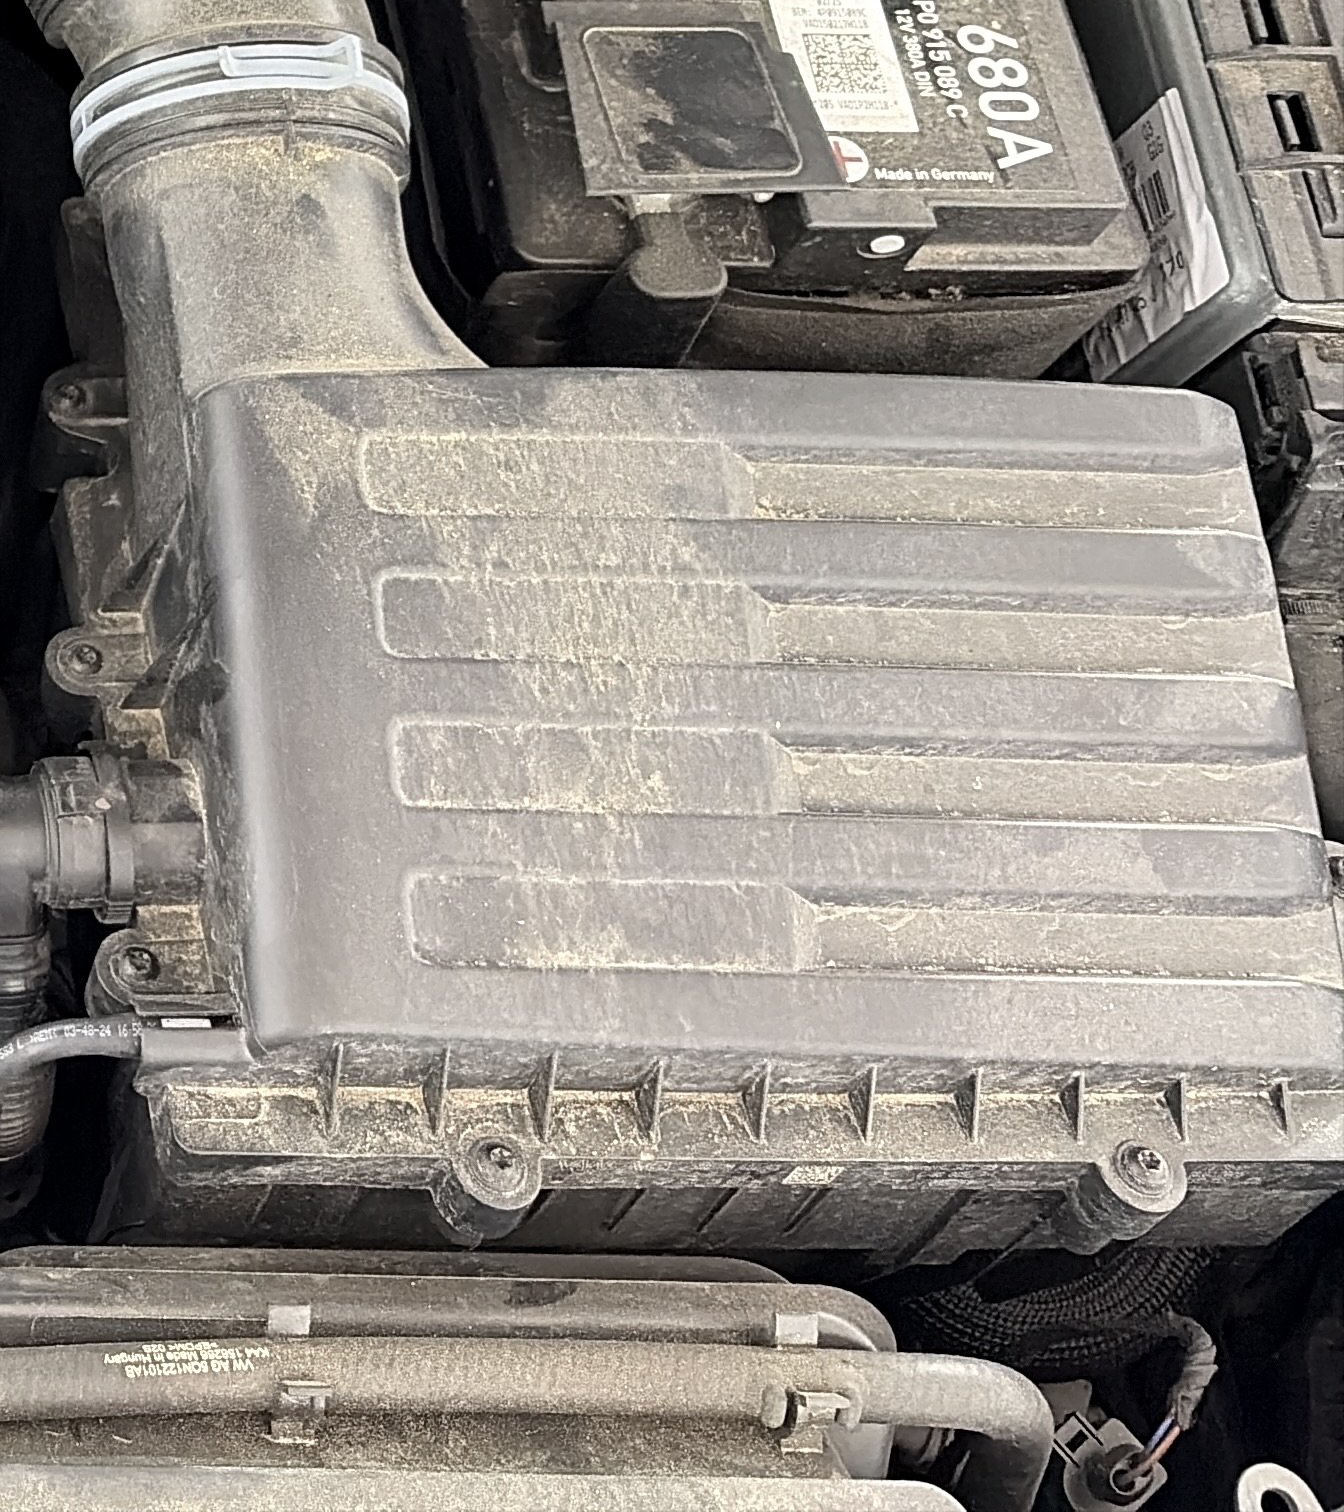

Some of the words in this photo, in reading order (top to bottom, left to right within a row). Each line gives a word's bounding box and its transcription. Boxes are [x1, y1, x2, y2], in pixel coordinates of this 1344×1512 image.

[894, 8, 916, 35] 12V
[903, 34, 926, 69] 380A
[922, 28, 952, 63] 915
[913, 70, 936, 98] DIN
[933, 65, 963, 101] 089
[952, 24, 1059, 170] 680A
[946, 104, 969, 119] C
[874, 167, 913, 182] Made
[915, 168, 930, 182] in
[932, 168, 996, 184] Germany
[103, 1351, 151, 1363] Hungary
[153, 1352, 164, 1363] in
[166, 1350, 198, 1361] Made
[232, 1357, 253, 1371] VW
[210, 1359, 229, 1372] AG
